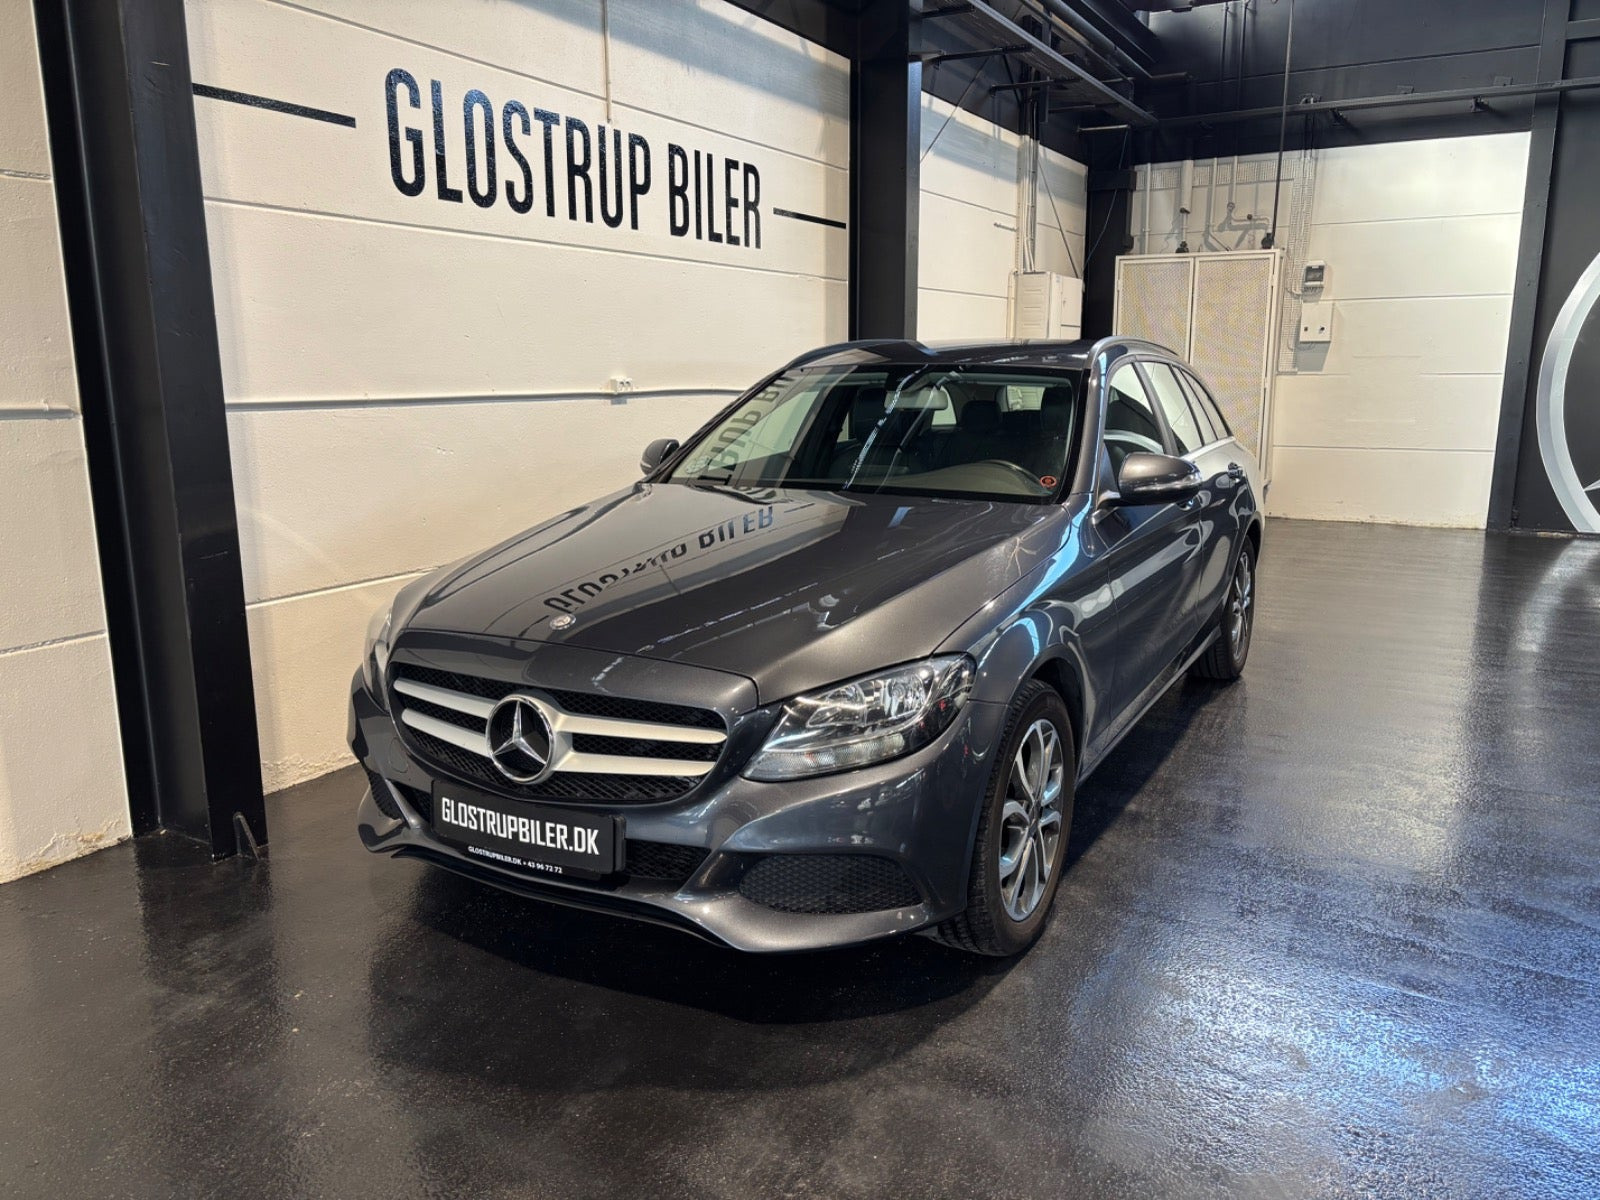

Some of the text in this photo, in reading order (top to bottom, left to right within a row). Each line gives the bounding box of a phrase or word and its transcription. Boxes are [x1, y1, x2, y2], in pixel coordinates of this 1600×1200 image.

[385, 69, 761, 249] GLOSTRUP BILER
[442, 797, 599, 856] GLOSTRUPBILER.DK
[468, 846, 522, 865] GLOSTRUPBILER.DK
